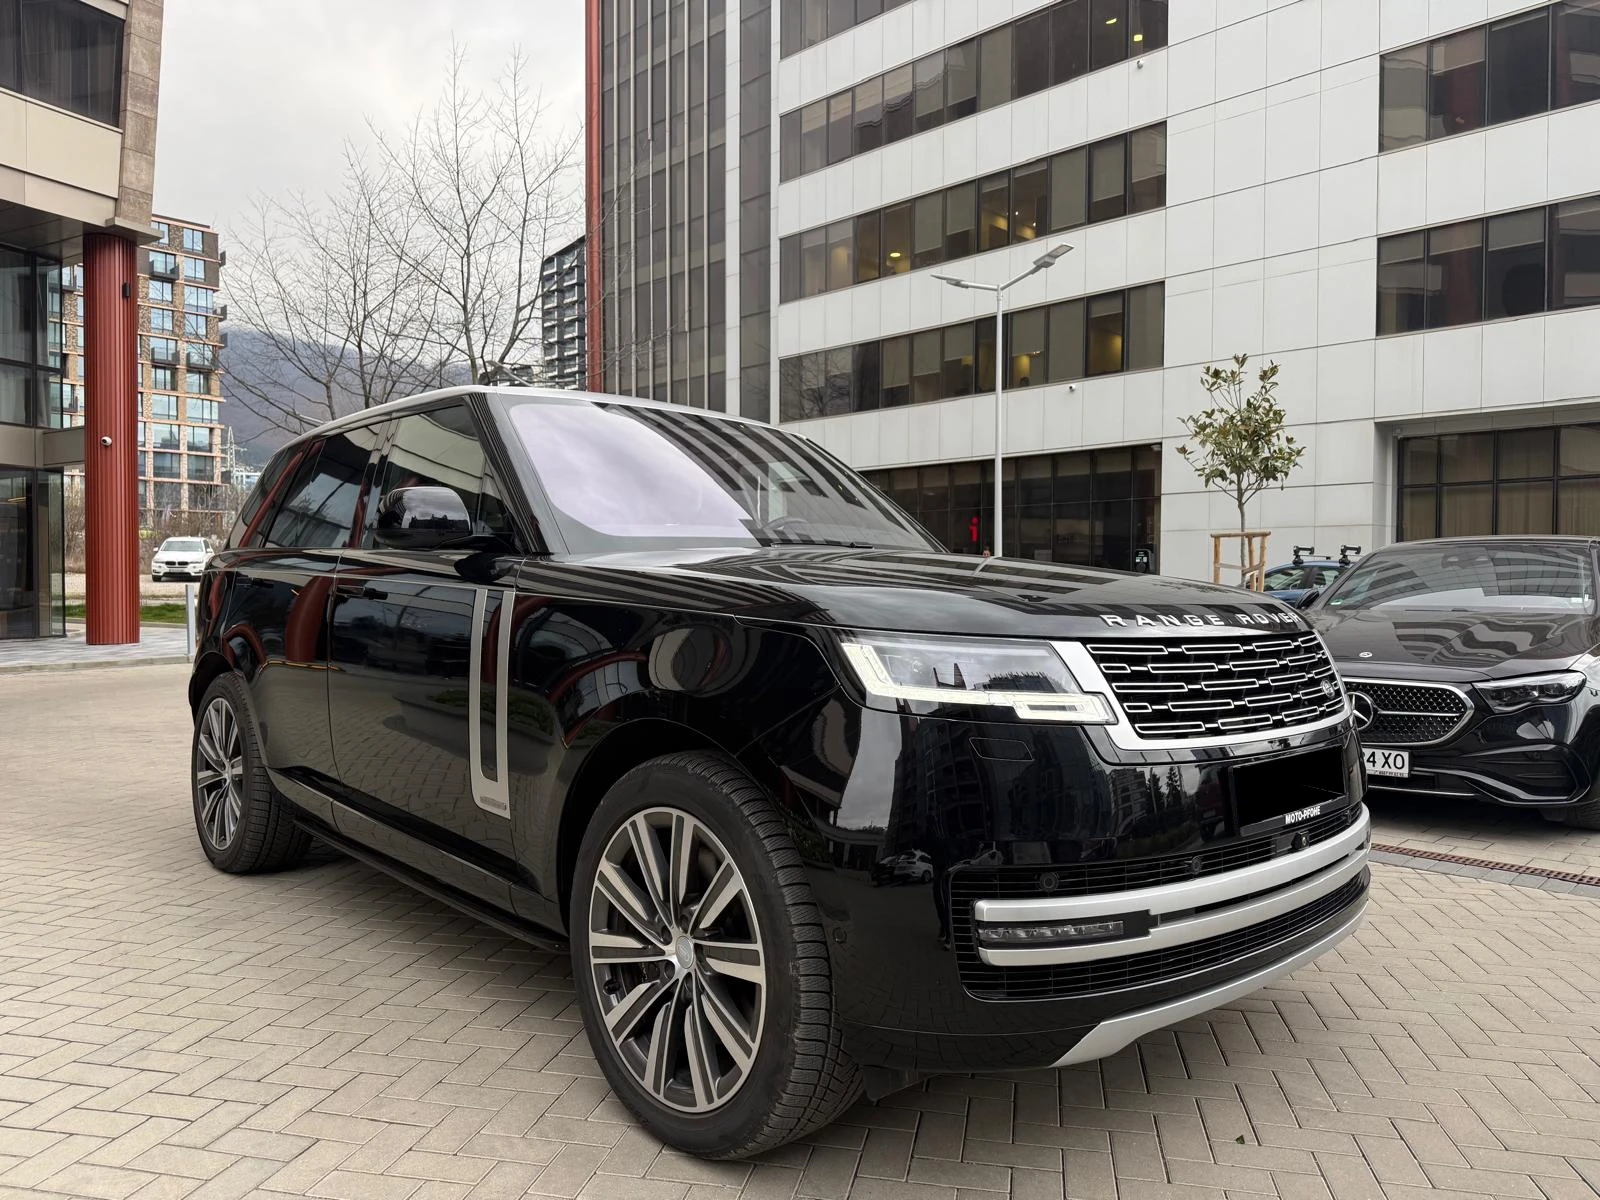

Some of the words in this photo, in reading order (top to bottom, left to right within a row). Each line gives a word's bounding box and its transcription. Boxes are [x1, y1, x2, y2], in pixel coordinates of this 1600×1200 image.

[1100, 614, 1225, 627] RANGE
[1235, 613, 1303, 625] ROVER
[1363, 751, 1377, 768] 4
